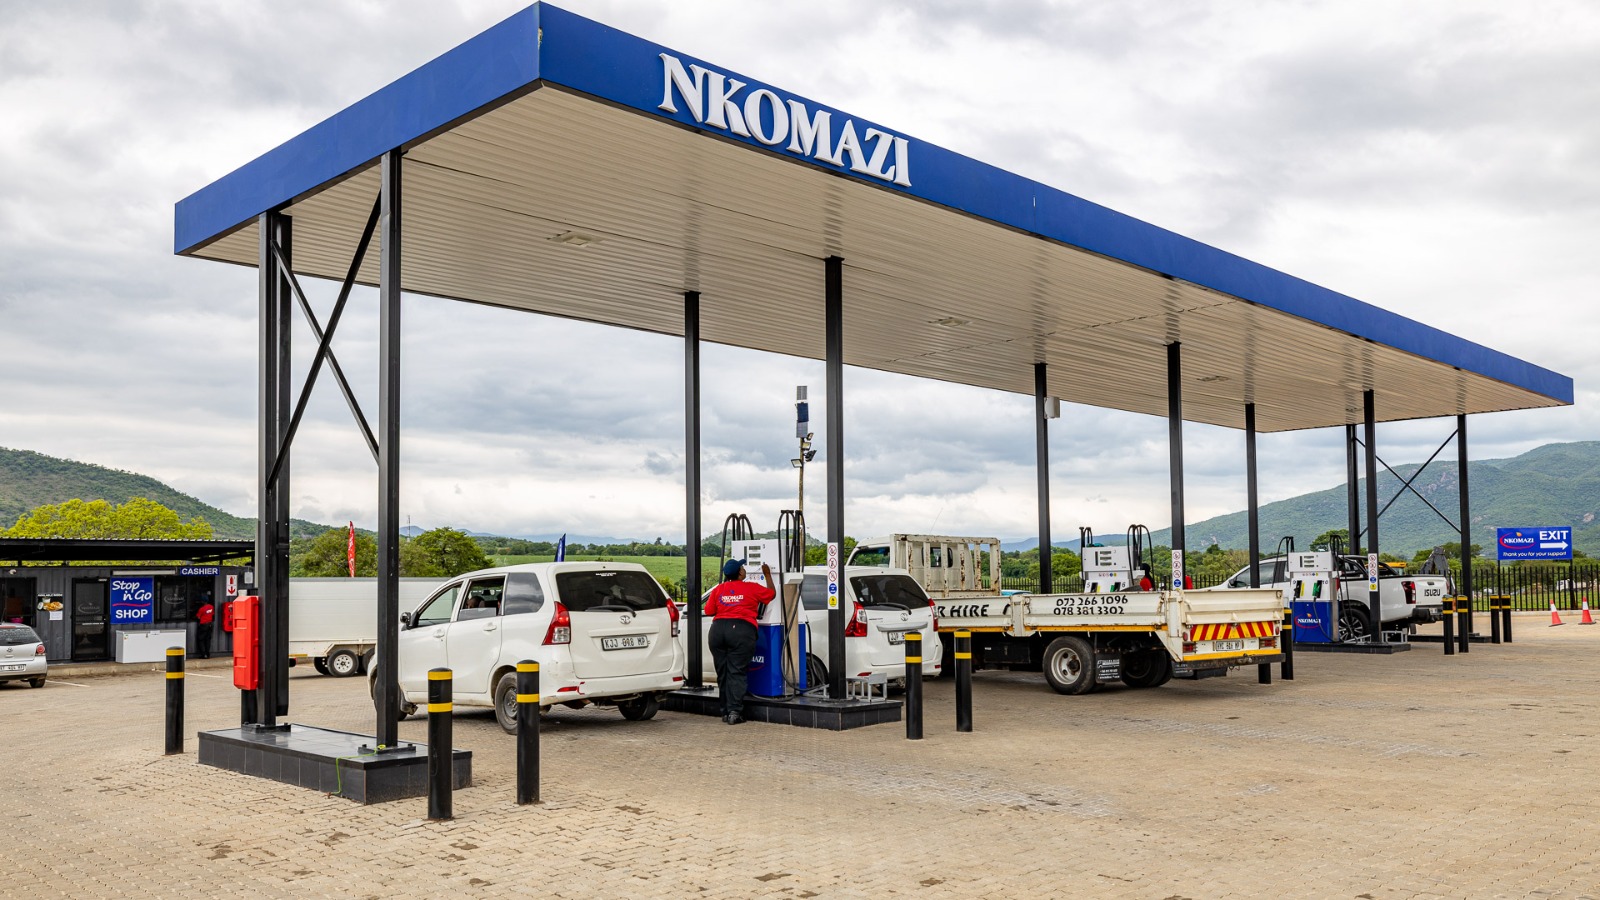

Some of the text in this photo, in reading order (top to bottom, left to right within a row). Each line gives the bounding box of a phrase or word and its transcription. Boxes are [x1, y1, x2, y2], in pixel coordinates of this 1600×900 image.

[658, 52, 912, 187] NKOMAZI
[1539, 530, 1569, 540] EXIT
[181, 567, 218, 575] CASHIER
[112, 580, 140, 593] Stop
[134, 589, 152, 602] Go
[1424, 588, 1441, 597] ISUZU
[1056, 594, 1128, 607] 072 266 1096
[115, 609, 148, 619] SHOP
[950, 604, 989, 618] HIRE
[1053, 606, 1125, 616] 078 381 3302
[604, 638, 619, 648] KJJ
